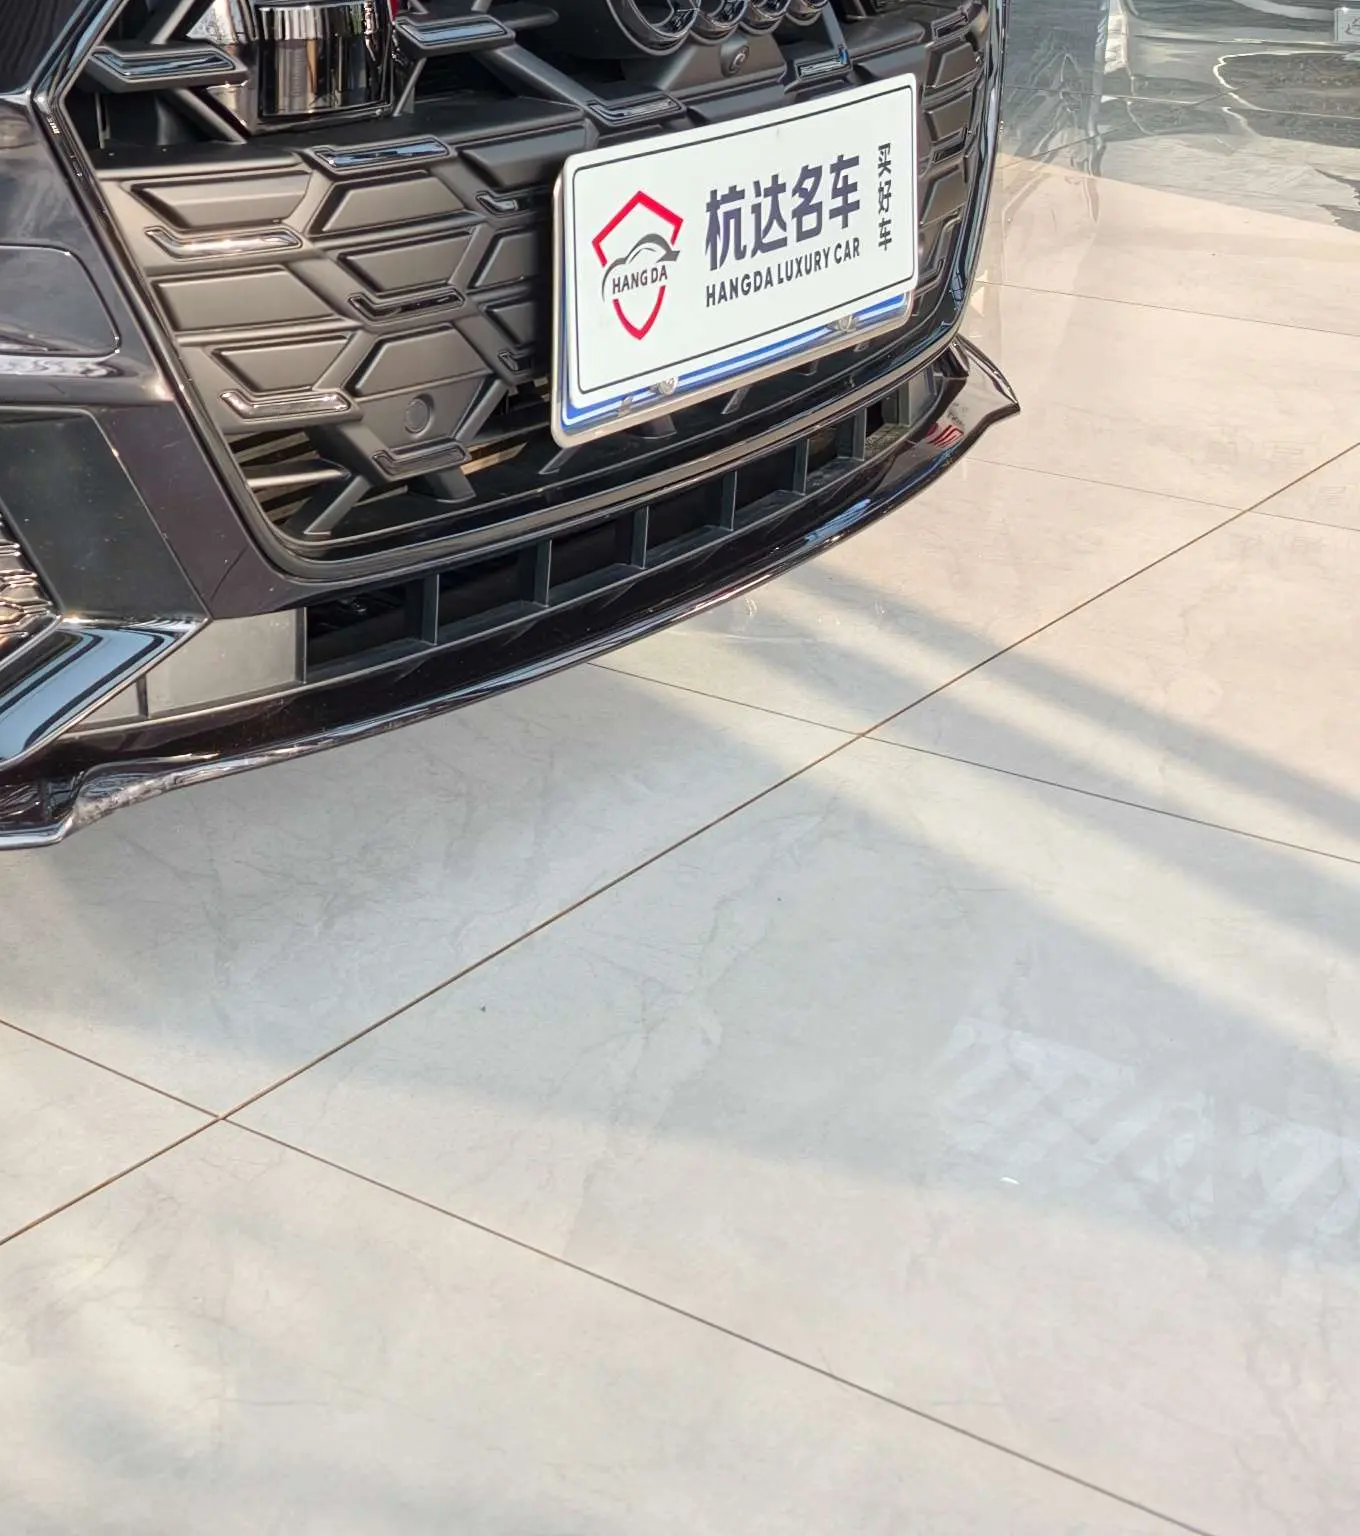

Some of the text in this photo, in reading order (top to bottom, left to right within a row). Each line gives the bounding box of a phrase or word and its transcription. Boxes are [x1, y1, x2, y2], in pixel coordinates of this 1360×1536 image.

[705, 154, 861, 271] 杭达名车
[877, 142, 893, 252] 买好车
[612, 265, 668, 294] HANG DA
[705, 237, 861, 307] HANGDA LUXURY CAR
